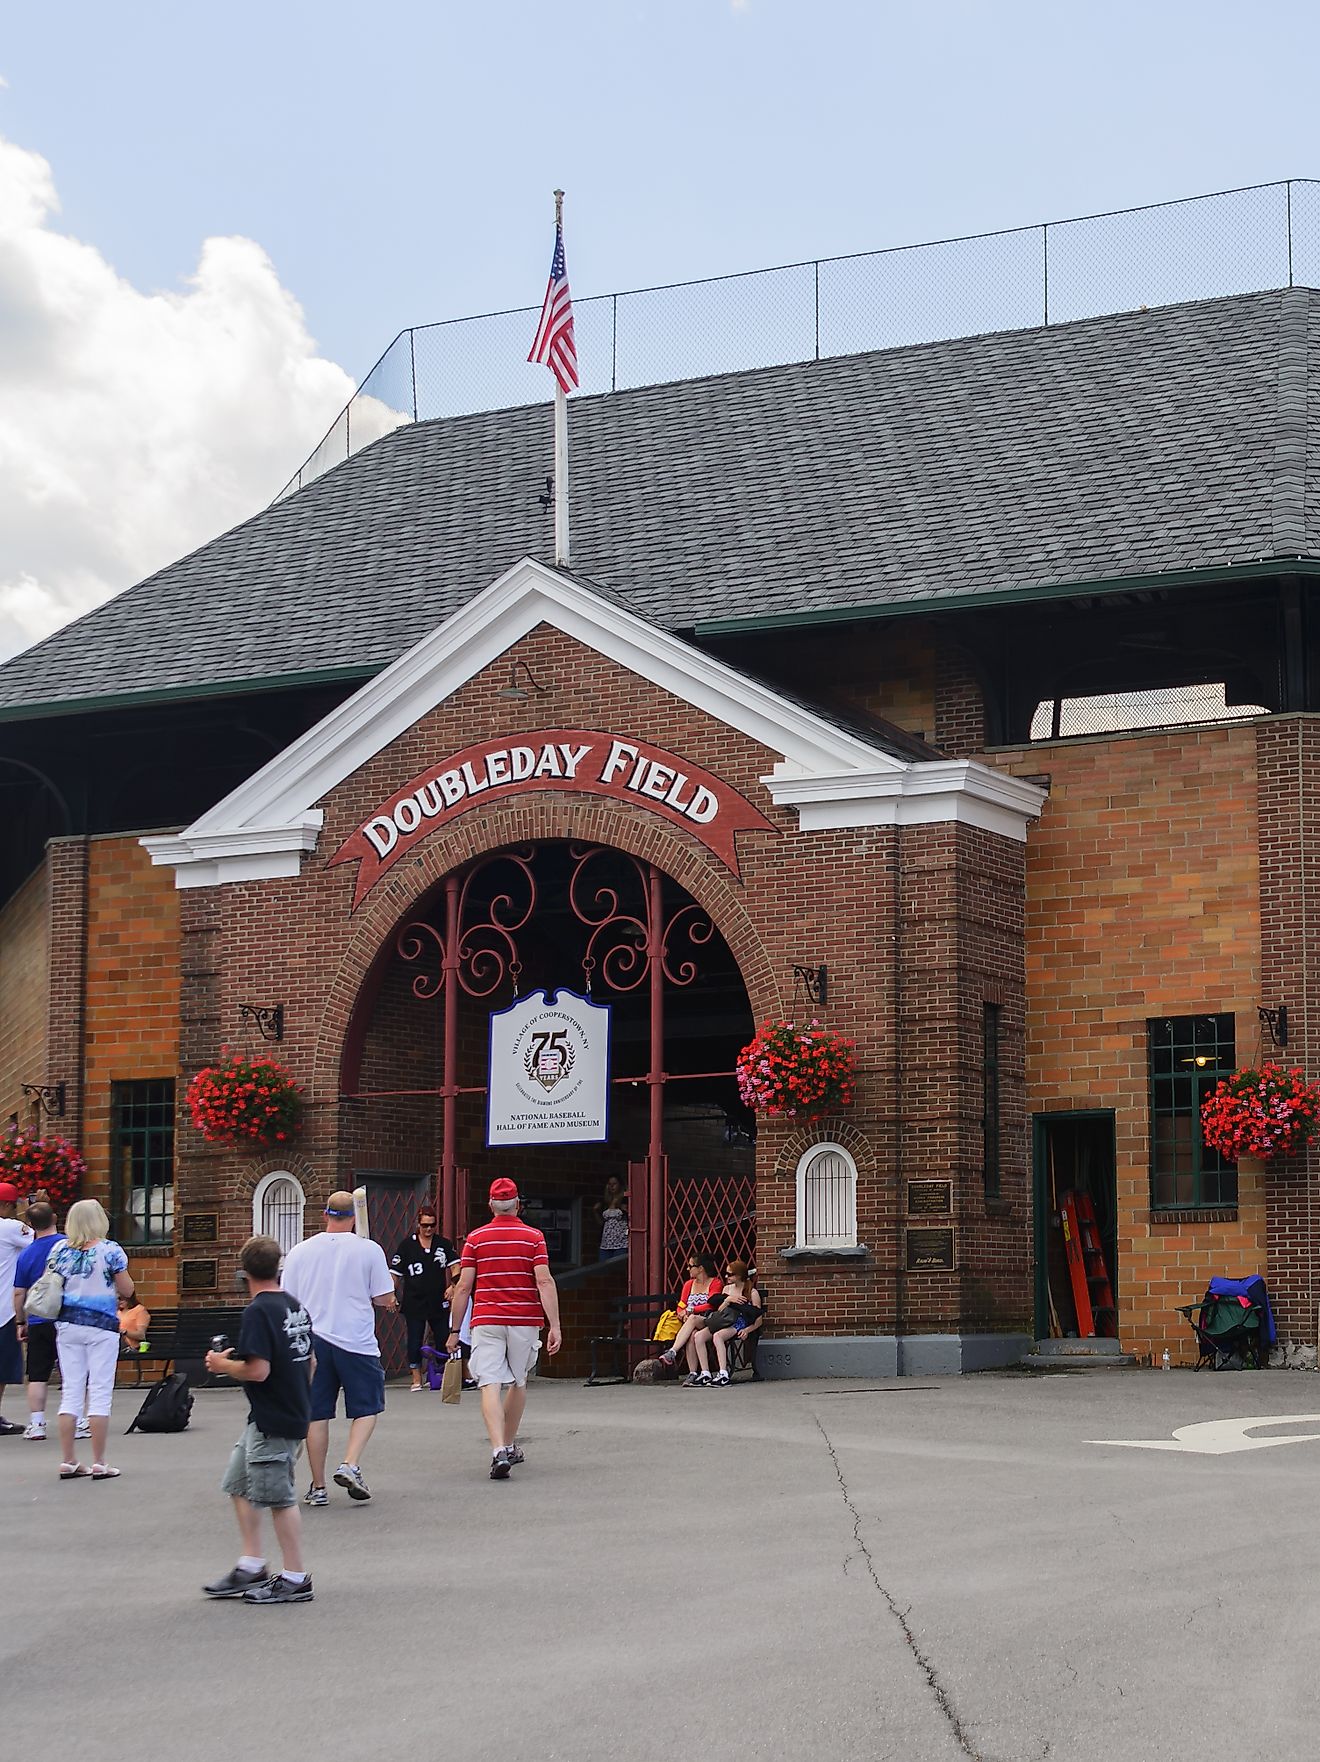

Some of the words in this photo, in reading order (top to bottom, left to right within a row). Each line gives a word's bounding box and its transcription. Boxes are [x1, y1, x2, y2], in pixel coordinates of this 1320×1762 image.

[364, 743, 593, 859] DOUBLEDAY
[601, 740, 719, 825] FIELD
[512, 1023, 531, 1055] VILLAGE
[531, 1029, 568, 1069] 75
[496, 1123, 516, 1131] HALL
[516, 1122, 527, 1130] OF
[527, 1121, 548, 1130] FAME
[549, 1121, 566, 1129] AND
[566, 1119, 600, 1128] MUSEUM
[510, 1113, 549, 1121] NATIONAL
[549, 1111, 586, 1120] BASEBALL
[408, 1262, 424, 1277] 13
